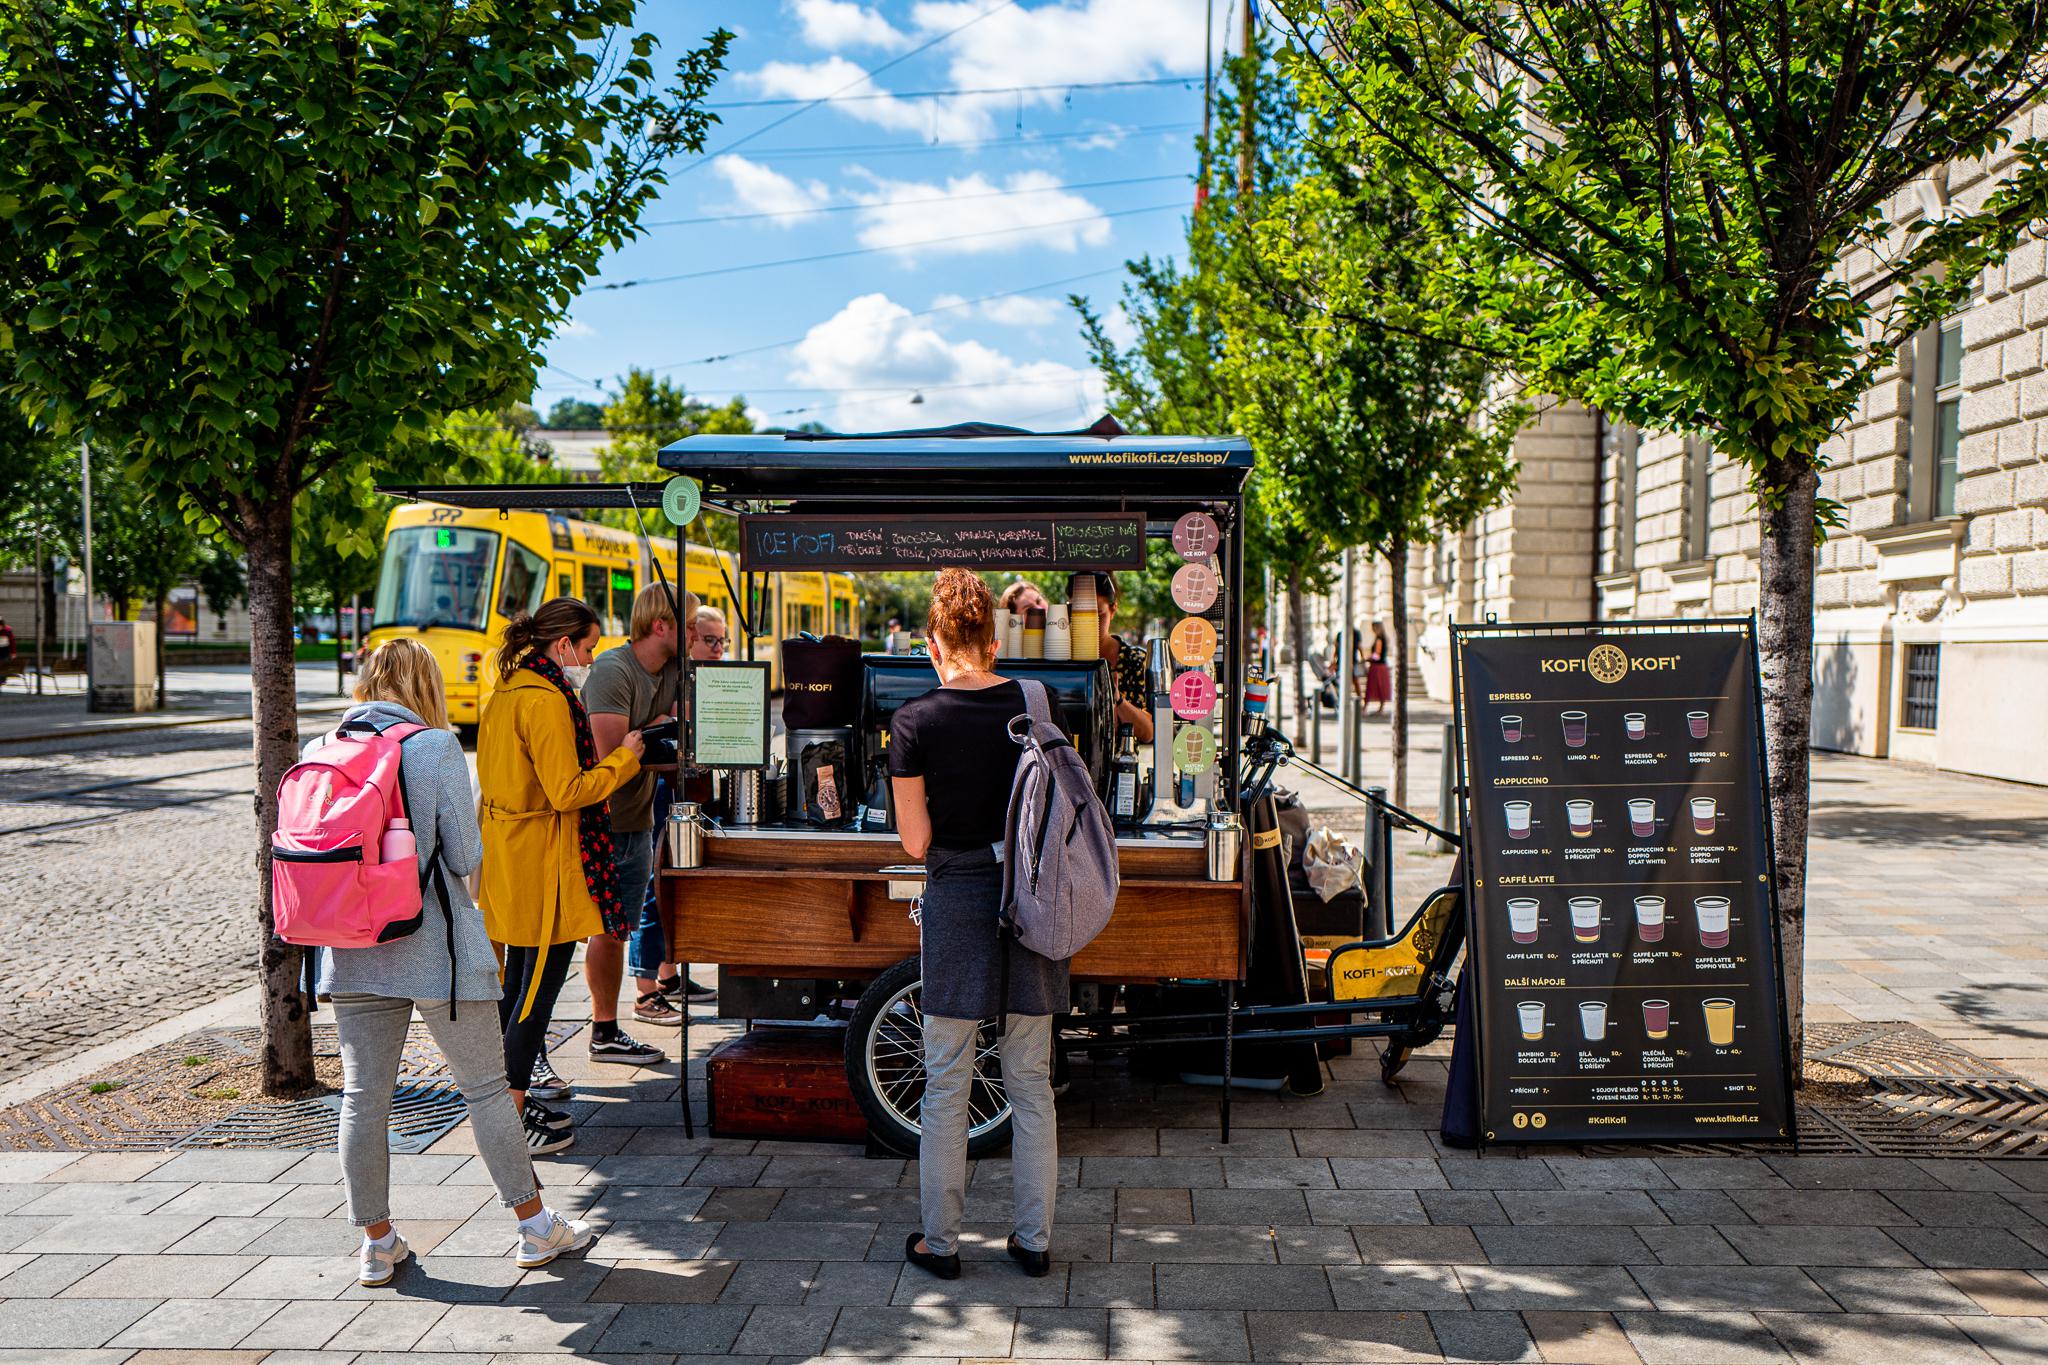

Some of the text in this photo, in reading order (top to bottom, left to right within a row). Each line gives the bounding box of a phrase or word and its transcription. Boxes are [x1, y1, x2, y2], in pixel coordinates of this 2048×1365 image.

[1069, 451, 1230, 465] www.kofikofi.cz/eshop/
[756, 531, 835, 558] ICE KOFI
[1541, 658, 1586, 673] KOFI
[1488, 693, 1532, 701] ESPRESSO
[1493, 777, 1549, 785] CAPPUCCINO
[1498, 875, 1555, 884] CAFFÉ LATTE
[1504, 977, 1566, 986] DALŠÍ NÁPOJE
[1588, 1115, 1628, 1125] #KofiKofi
[1694, 1115, 1759, 1123] www.kofikofi.cz
